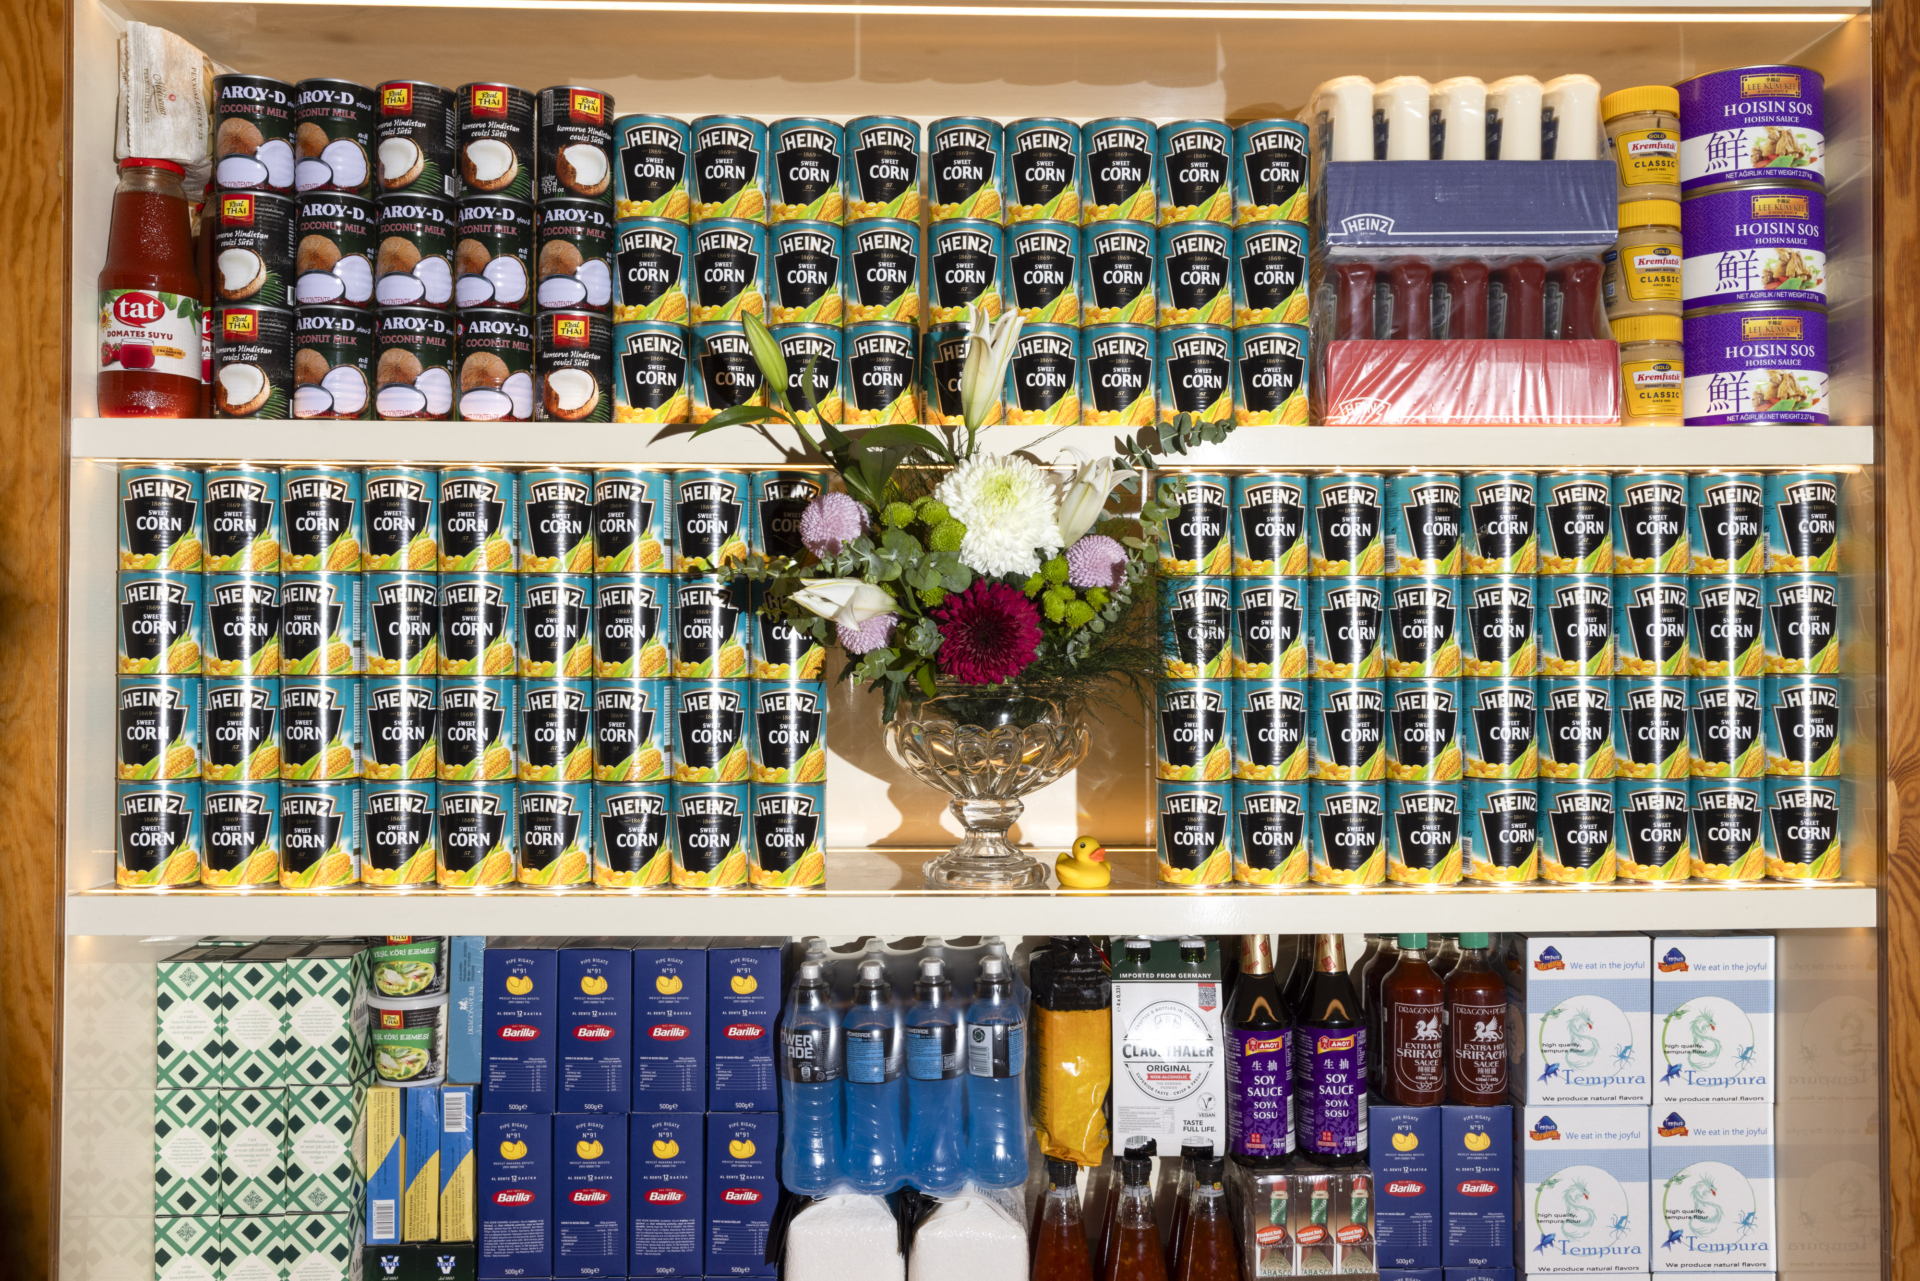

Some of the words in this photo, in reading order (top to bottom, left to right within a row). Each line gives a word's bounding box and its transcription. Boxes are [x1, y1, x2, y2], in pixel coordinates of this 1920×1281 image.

[1784, 82, 1796, 90] KEE
[222, 86, 286, 105] AROY-D
[482, 90, 497, 98] Real
[478, 98, 500, 106] THAI
[1724, 101, 1787, 116] HOISIN
[1789, 101, 1812, 115] SOS
[220, 104, 264, 114] COCONUT
[267, 108, 288, 119] MILK
[488, 121, 520, 132] Hindistan
[628, 130, 680, 150] HEINZ
[863, 130, 913, 151] HEINZ
[1096, 132, 1147, 152] HEINZ
[1705, 129, 1749, 173] 鮮
[634, 164, 675, 180] CORN
[869, 165, 909, 180] CORN
[1634, 161, 1675, 169] CLASSIC
[1101, 167, 1141, 182] CORN
[1350, 218, 1388, 233] HEINZ
[700, 234, 750, 253] HEINZ
[1249, 238, 1298, 256] HEINZ
[704, 268, 745, 283] CORN
[1254, 271, 1295, 285] CORN
[119, 298, 158, 319] tat
[148, 332, 173, 340] SUYU
[469, 321, 529, 337] AROY-D
[560, 327, 582, 335] THAI
[466, 339, 510, 348] COCONUT
[513, 341, 530, 351] MILK
[1178, 340, 1226, 359] HEINZ
[1725, 344, 1788, 358] HOISIN
[1790, 344, 1815, 357] SOS
[570, 350, 601, 360] Hindistan
[1182, 374, 1222, 389] CORN
[1706, 372, 1750, 413] 鮮
[132, 482, 188, 500] HEINZ
[367, 482, 421, 501] HEINZ
[1630, 487, 1680, 505] HEINZ
[136, 517, 182, 531] CORN
[373, 517, 415, 532] CORN
[1636, 521, 1678, 535] CORN
[208, 798, 260, 815] HEINZ
[684, 800, 735, 816] HEINZ
[1170, 798, 1218, 815] HEINZ
[1781, 794, 1831, 809] HEINZ
[212, 832, 255, 846] CORN
[689, 834, 730, 848] CORN
[1174, 832, 1215, 846] CORN
[1787, 826, 1830, 841] CORN
[1570, 962, 1584, 970] We
[1622, 961, 1645, 970] joyful
[1456, 1007, 1489, 1015] DRAGON
[502, 1028, 535, 1037] Barilla
[1254, 1076, 1276, 1085] SOY
[1326, 1074, 1348, 1083] SOY
[1562, 1070, 1646, 1088] Tempura
[1247, 1086, 1282, 1096] SAUCE
[1319, 1085, 1354, 1095] SAUCE
[650, 1192, 681, 1201] Barilla
[1686, 1235, 1769, 1253] Tempura
